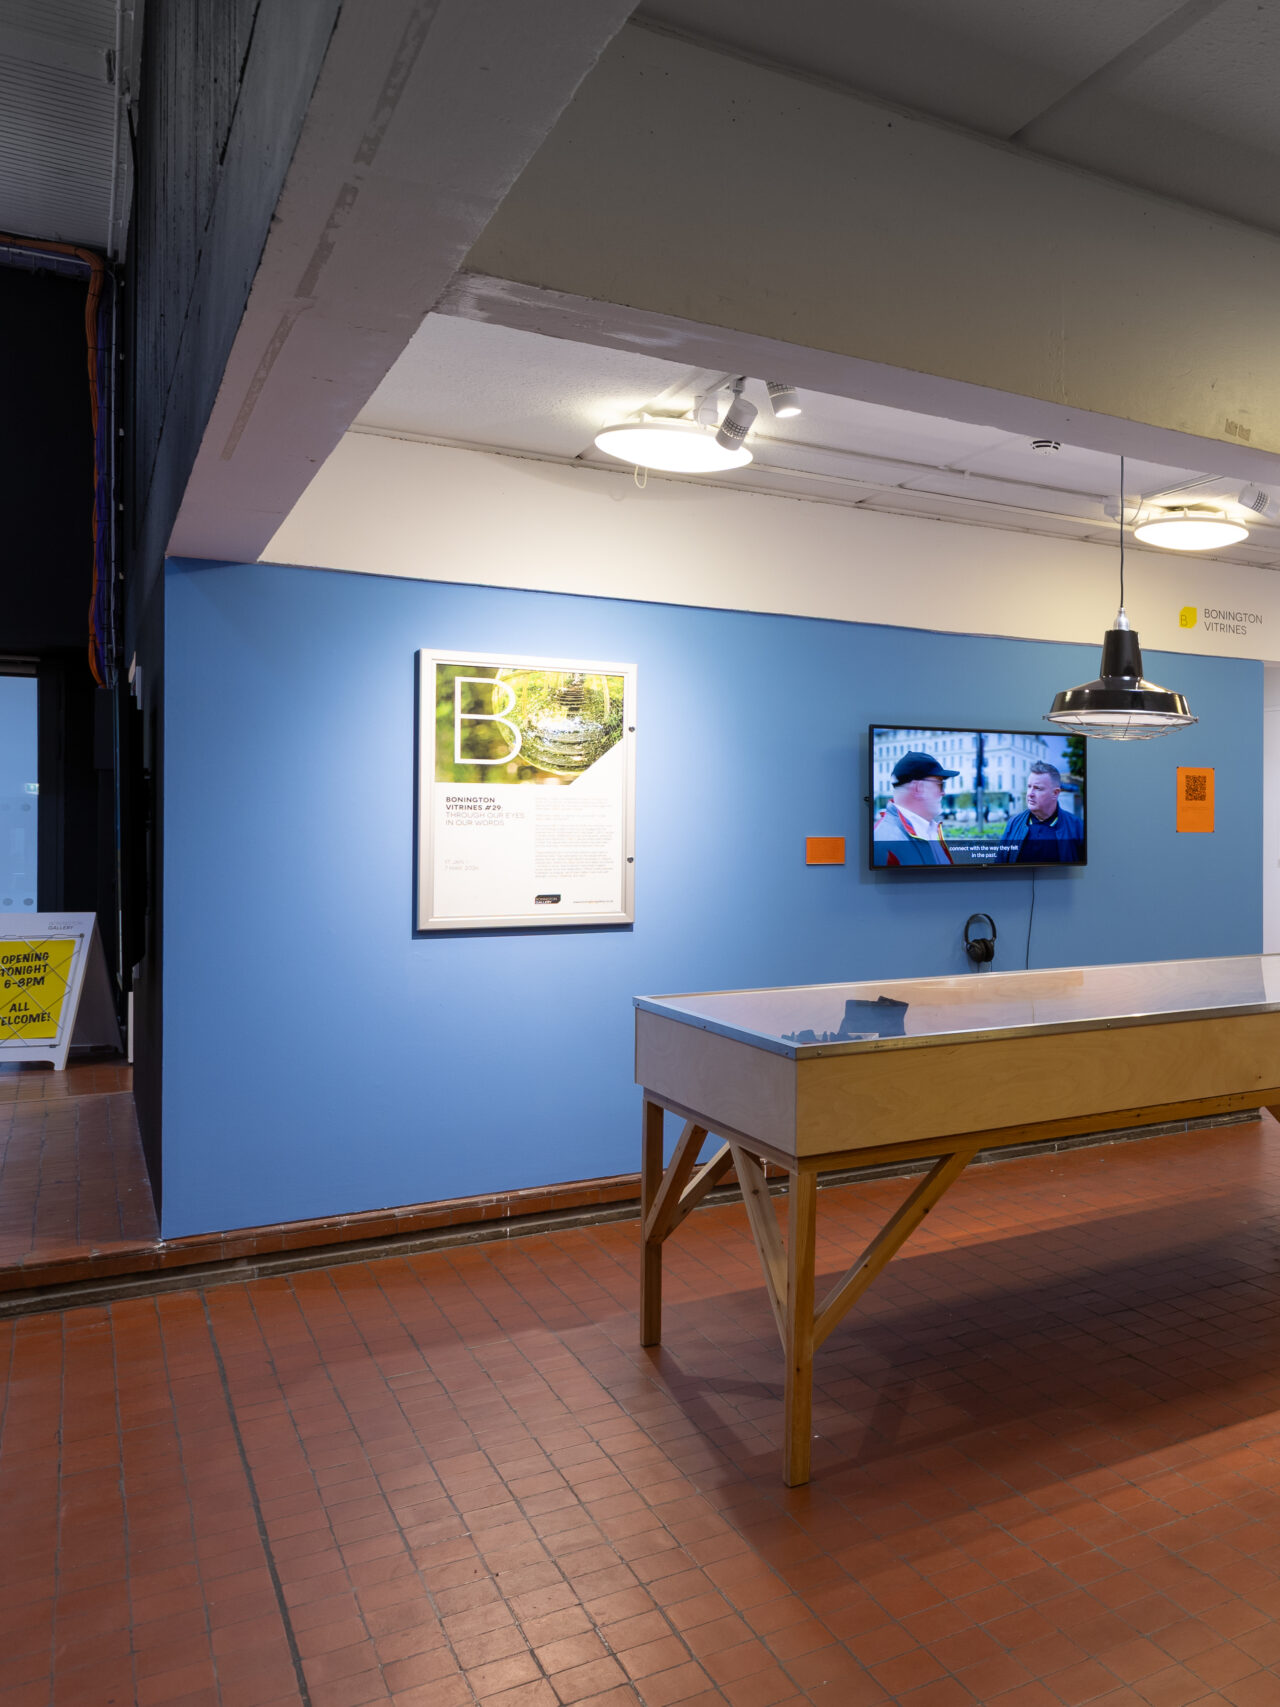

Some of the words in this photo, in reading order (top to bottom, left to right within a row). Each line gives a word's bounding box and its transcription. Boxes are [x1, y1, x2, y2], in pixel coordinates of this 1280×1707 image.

[1180, 614, 1188, 627] B
[1204, 608, 1263, 625] BONINGTON
[1204, 622, 1247, 635] VITRINES
[454, 676, 523, 765] B
[1, 952, 49, 964] OPENING
[0, 964, 48, 977] TONIGHT
[4, 976, 46, 989] 6-8PM
[9, 1002, 30, 1013] ALL
[0, 1012, 51, 1027] ELCOME!
